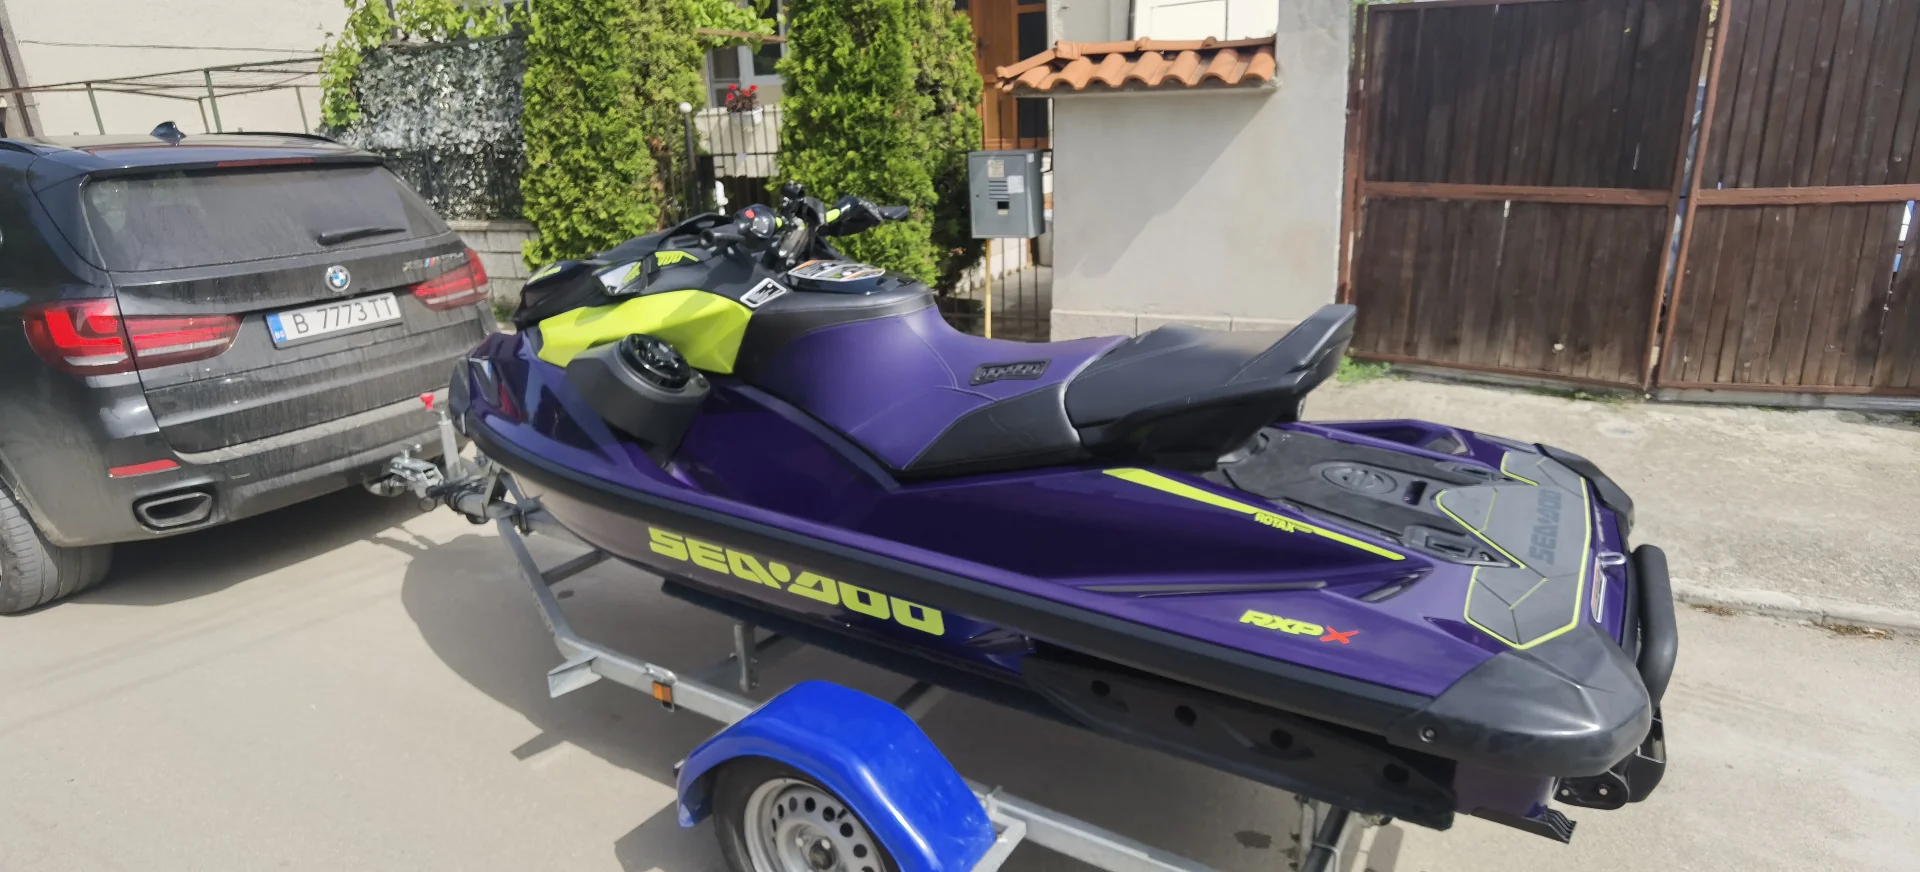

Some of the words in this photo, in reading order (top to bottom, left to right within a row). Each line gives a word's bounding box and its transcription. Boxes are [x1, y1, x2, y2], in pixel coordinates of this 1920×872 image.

[292, 313, 309, 334] B
[317, 302, 368, 329] 7773
[368, 296, 392, 319] TT
[1254, 512, 1295, 533] ROTAX
